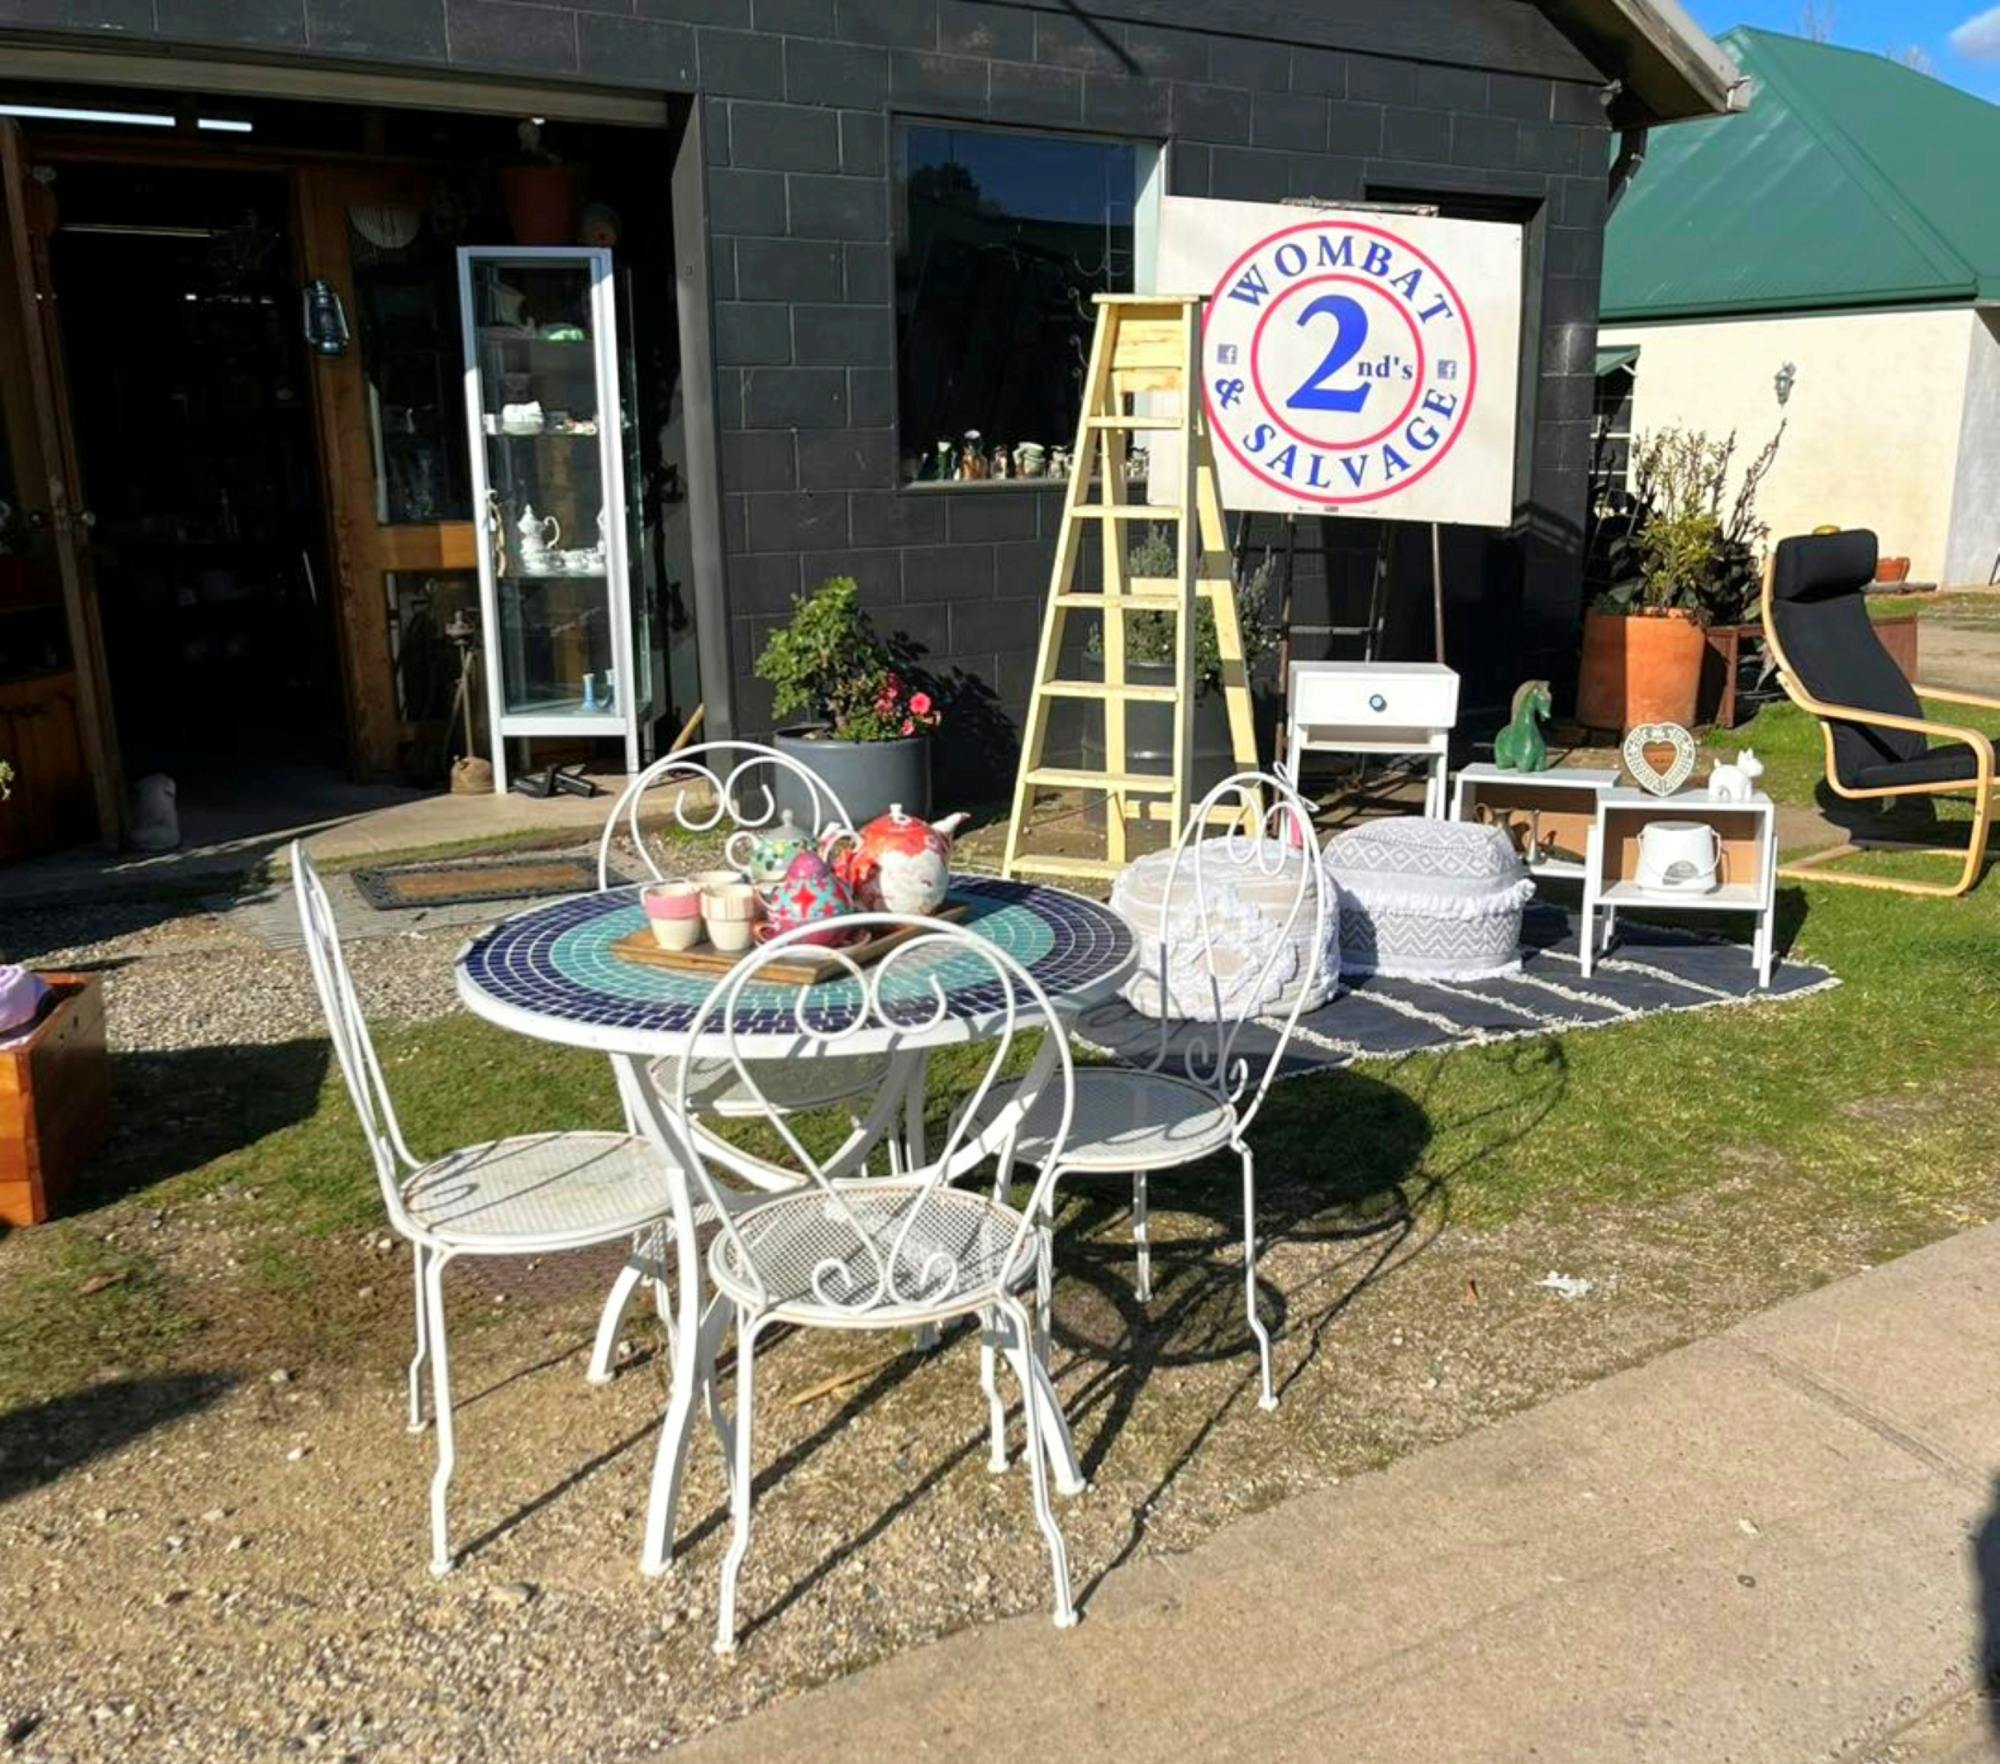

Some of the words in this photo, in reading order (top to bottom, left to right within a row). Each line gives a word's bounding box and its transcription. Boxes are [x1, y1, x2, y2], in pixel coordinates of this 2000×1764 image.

[1227, 234, 1454, 324] WOMBAT
[1214, 378, 1245, 410] &
[1243, 388, 1458, 488] SALVAGE
